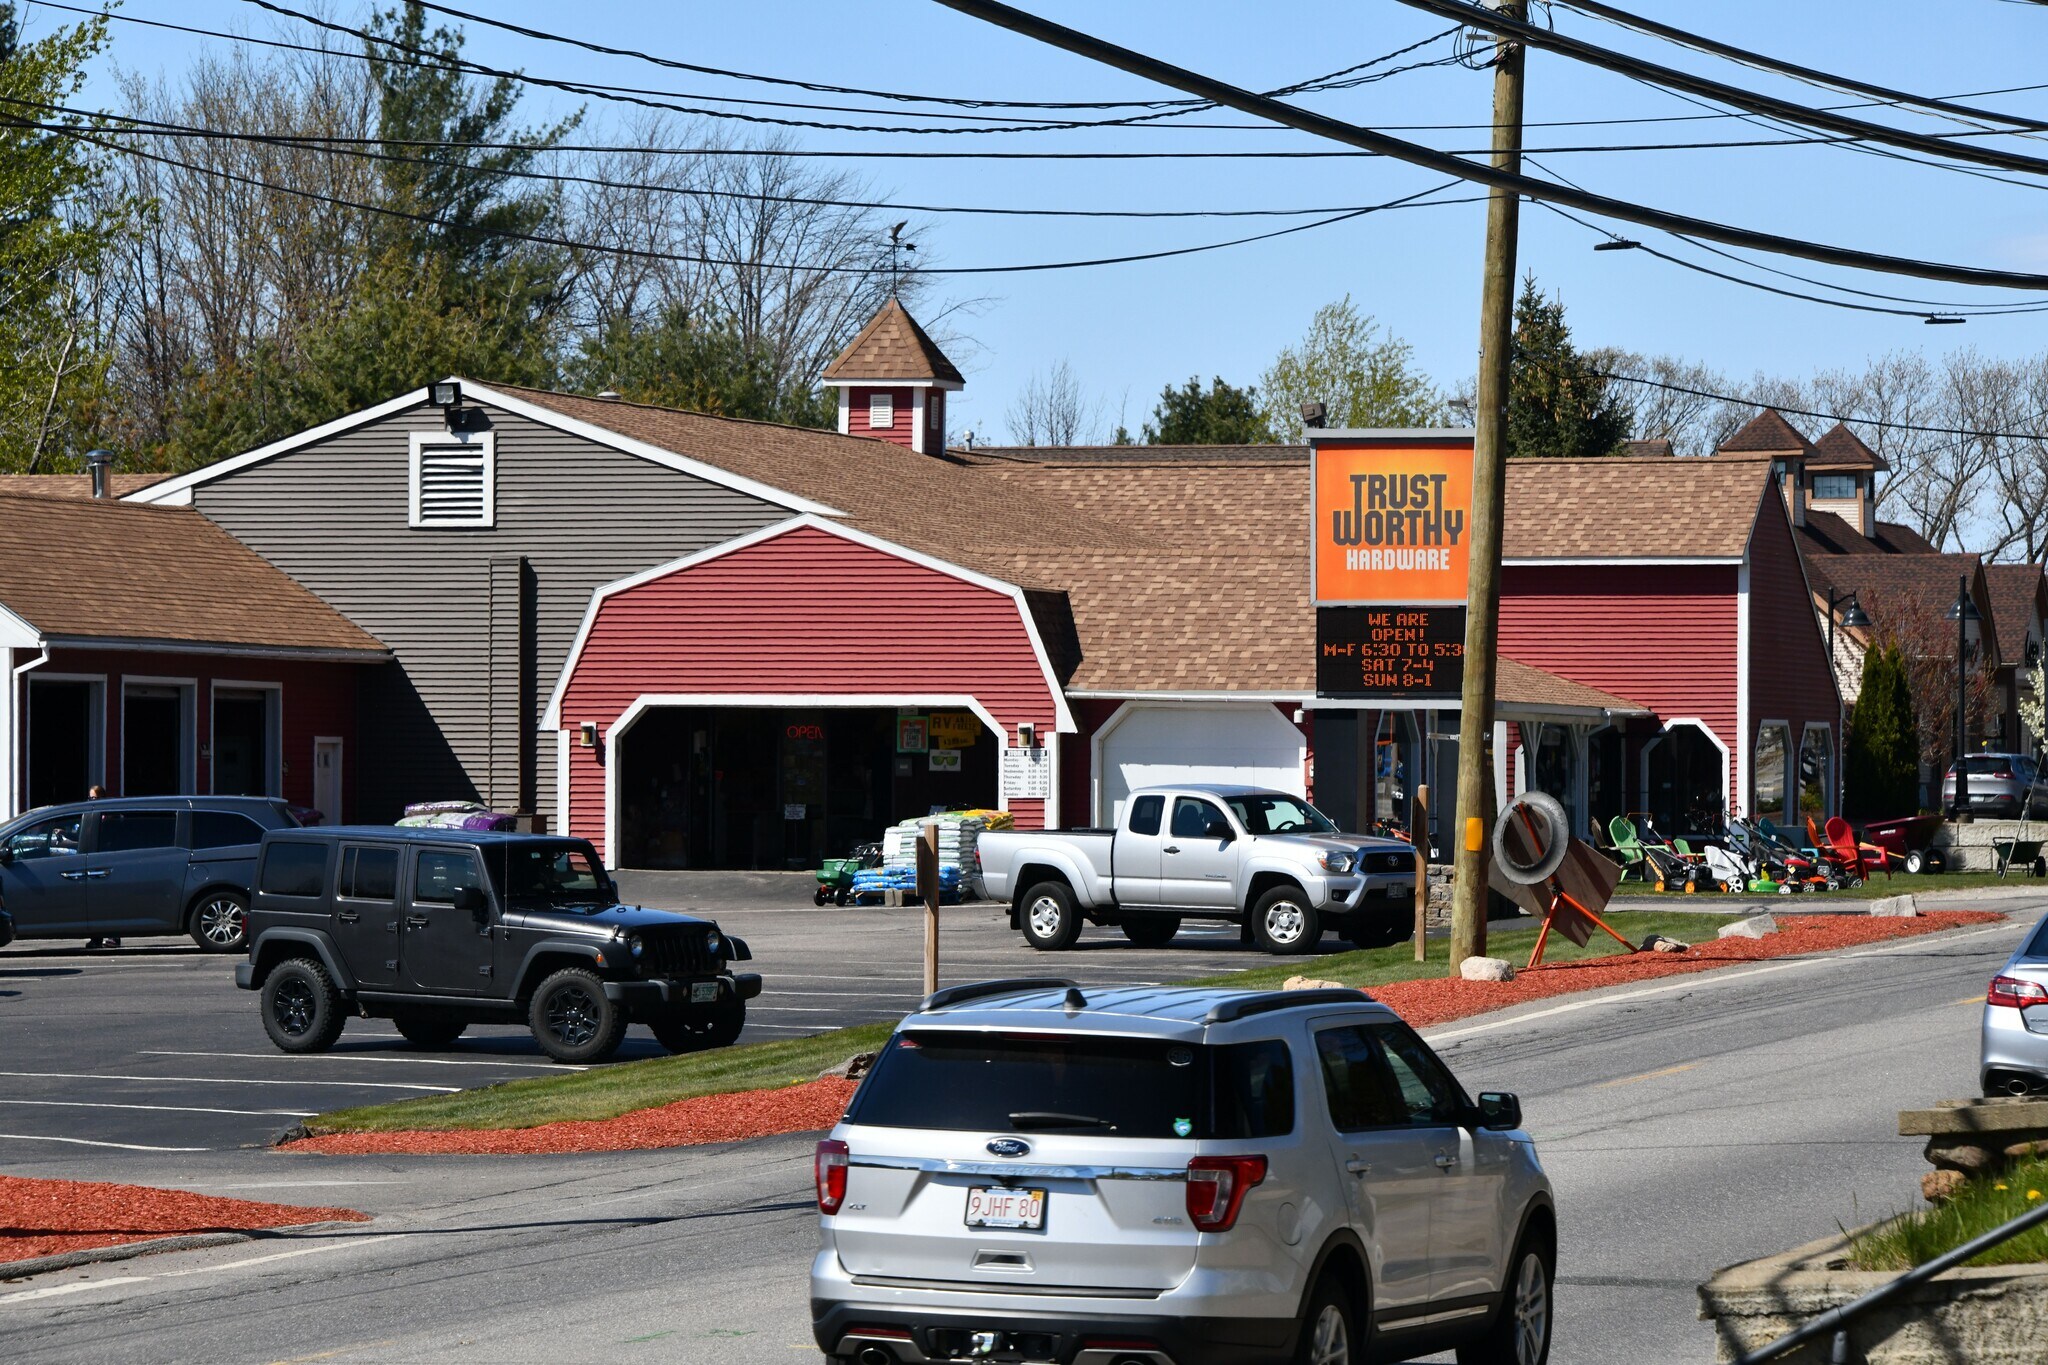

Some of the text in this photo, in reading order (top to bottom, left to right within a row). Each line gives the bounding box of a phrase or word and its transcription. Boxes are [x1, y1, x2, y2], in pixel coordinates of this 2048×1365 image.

[1349, 474, 1447, 510] TRUST
[1333, 509, 1464, 546] WORTHY
[1346, 548, 1450, 571] HARDWARE
[1368, 613, 1429, 627] WE ARE
[1371, 628, 1424, 641] OPEN!
[1323, 643, 1467, 657] M-F 6:30 TO 5:3
[1361, 658, 1434, 671] SAT 7-4
[1363, 673, 1432, 687] SUN 8-1
[786, 725, 824, 739] OPEN
[1018, 1198, 1040, 1218] 80
